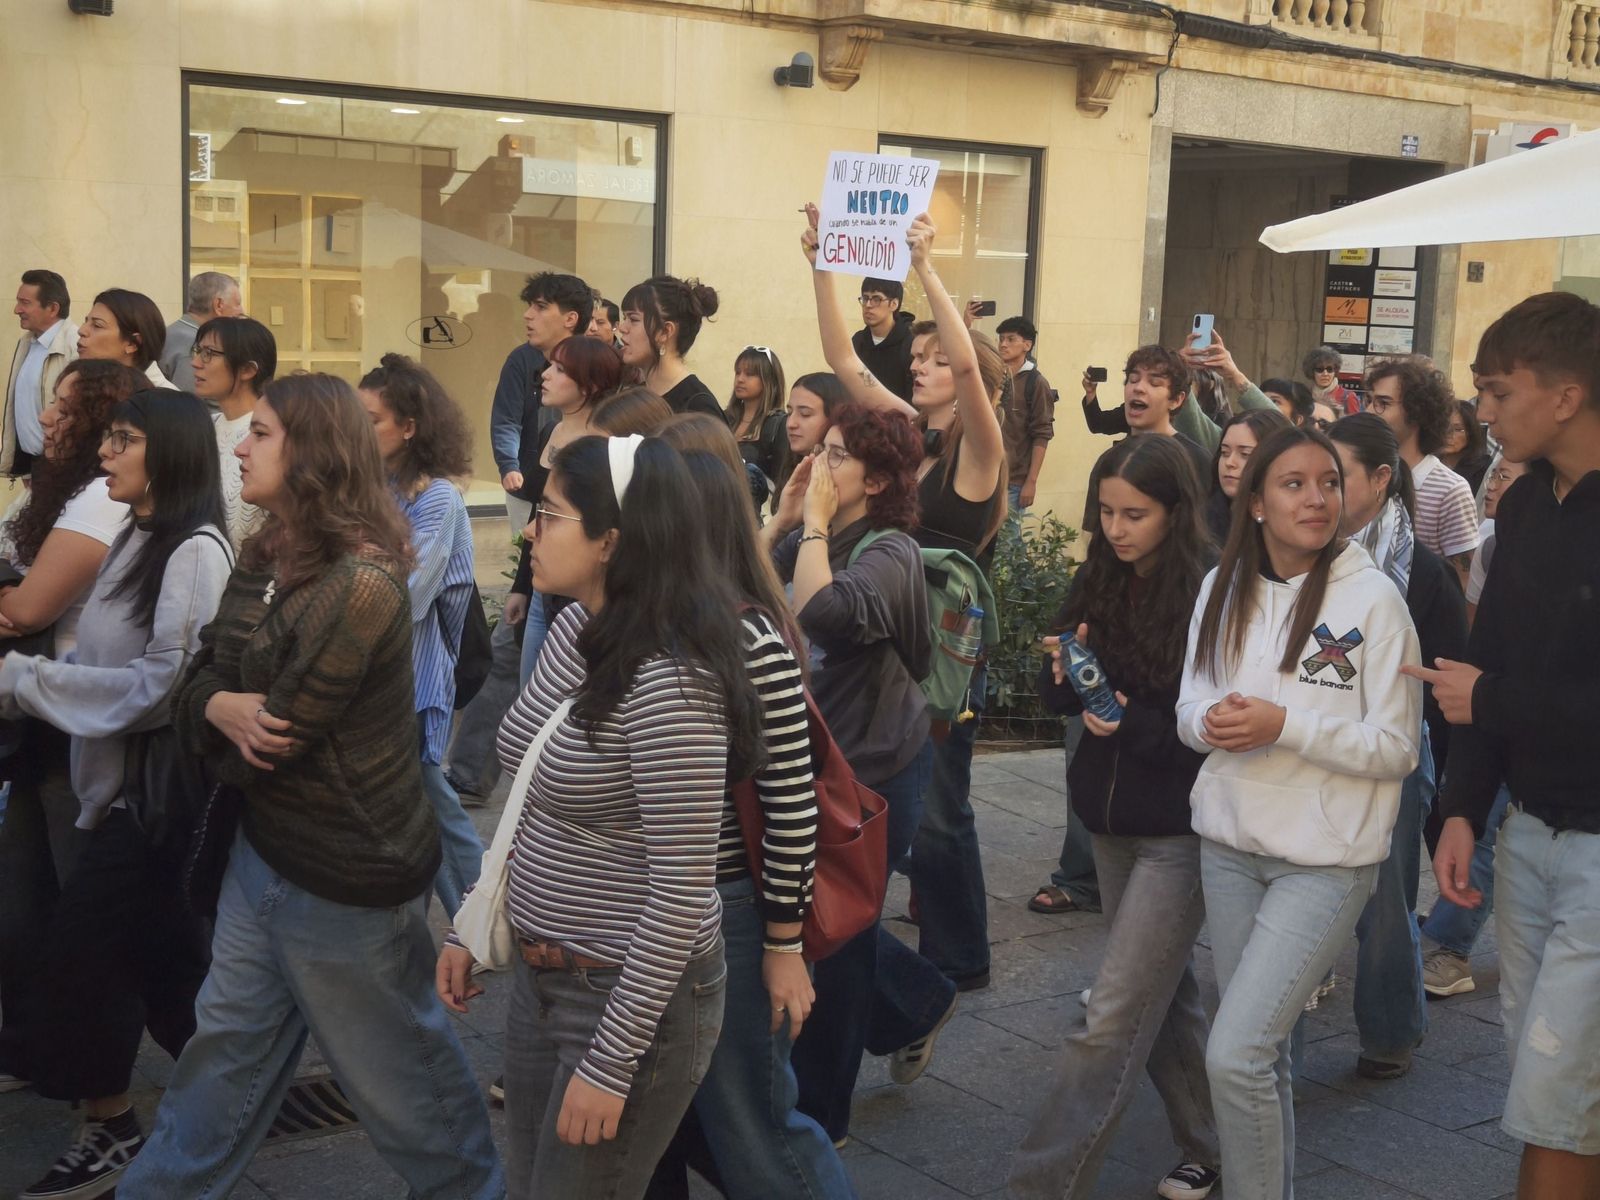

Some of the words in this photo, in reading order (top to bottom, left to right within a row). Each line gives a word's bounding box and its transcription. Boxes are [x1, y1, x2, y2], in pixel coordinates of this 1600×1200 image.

[833, 159, 848, 182] NO
[850, 160, 864, 184] SE
[868, 162, 904, 185] PUEDE
[905, 165, 930, 188] SER
[847, 189, 909, 216] NEUTRO
[889, 219, 898, 227] un
[1385, 306, 1410, 314] ALQUILA
[1299, 674, 1318, 685] blue
[1320, 678, 1354, 691] banana
